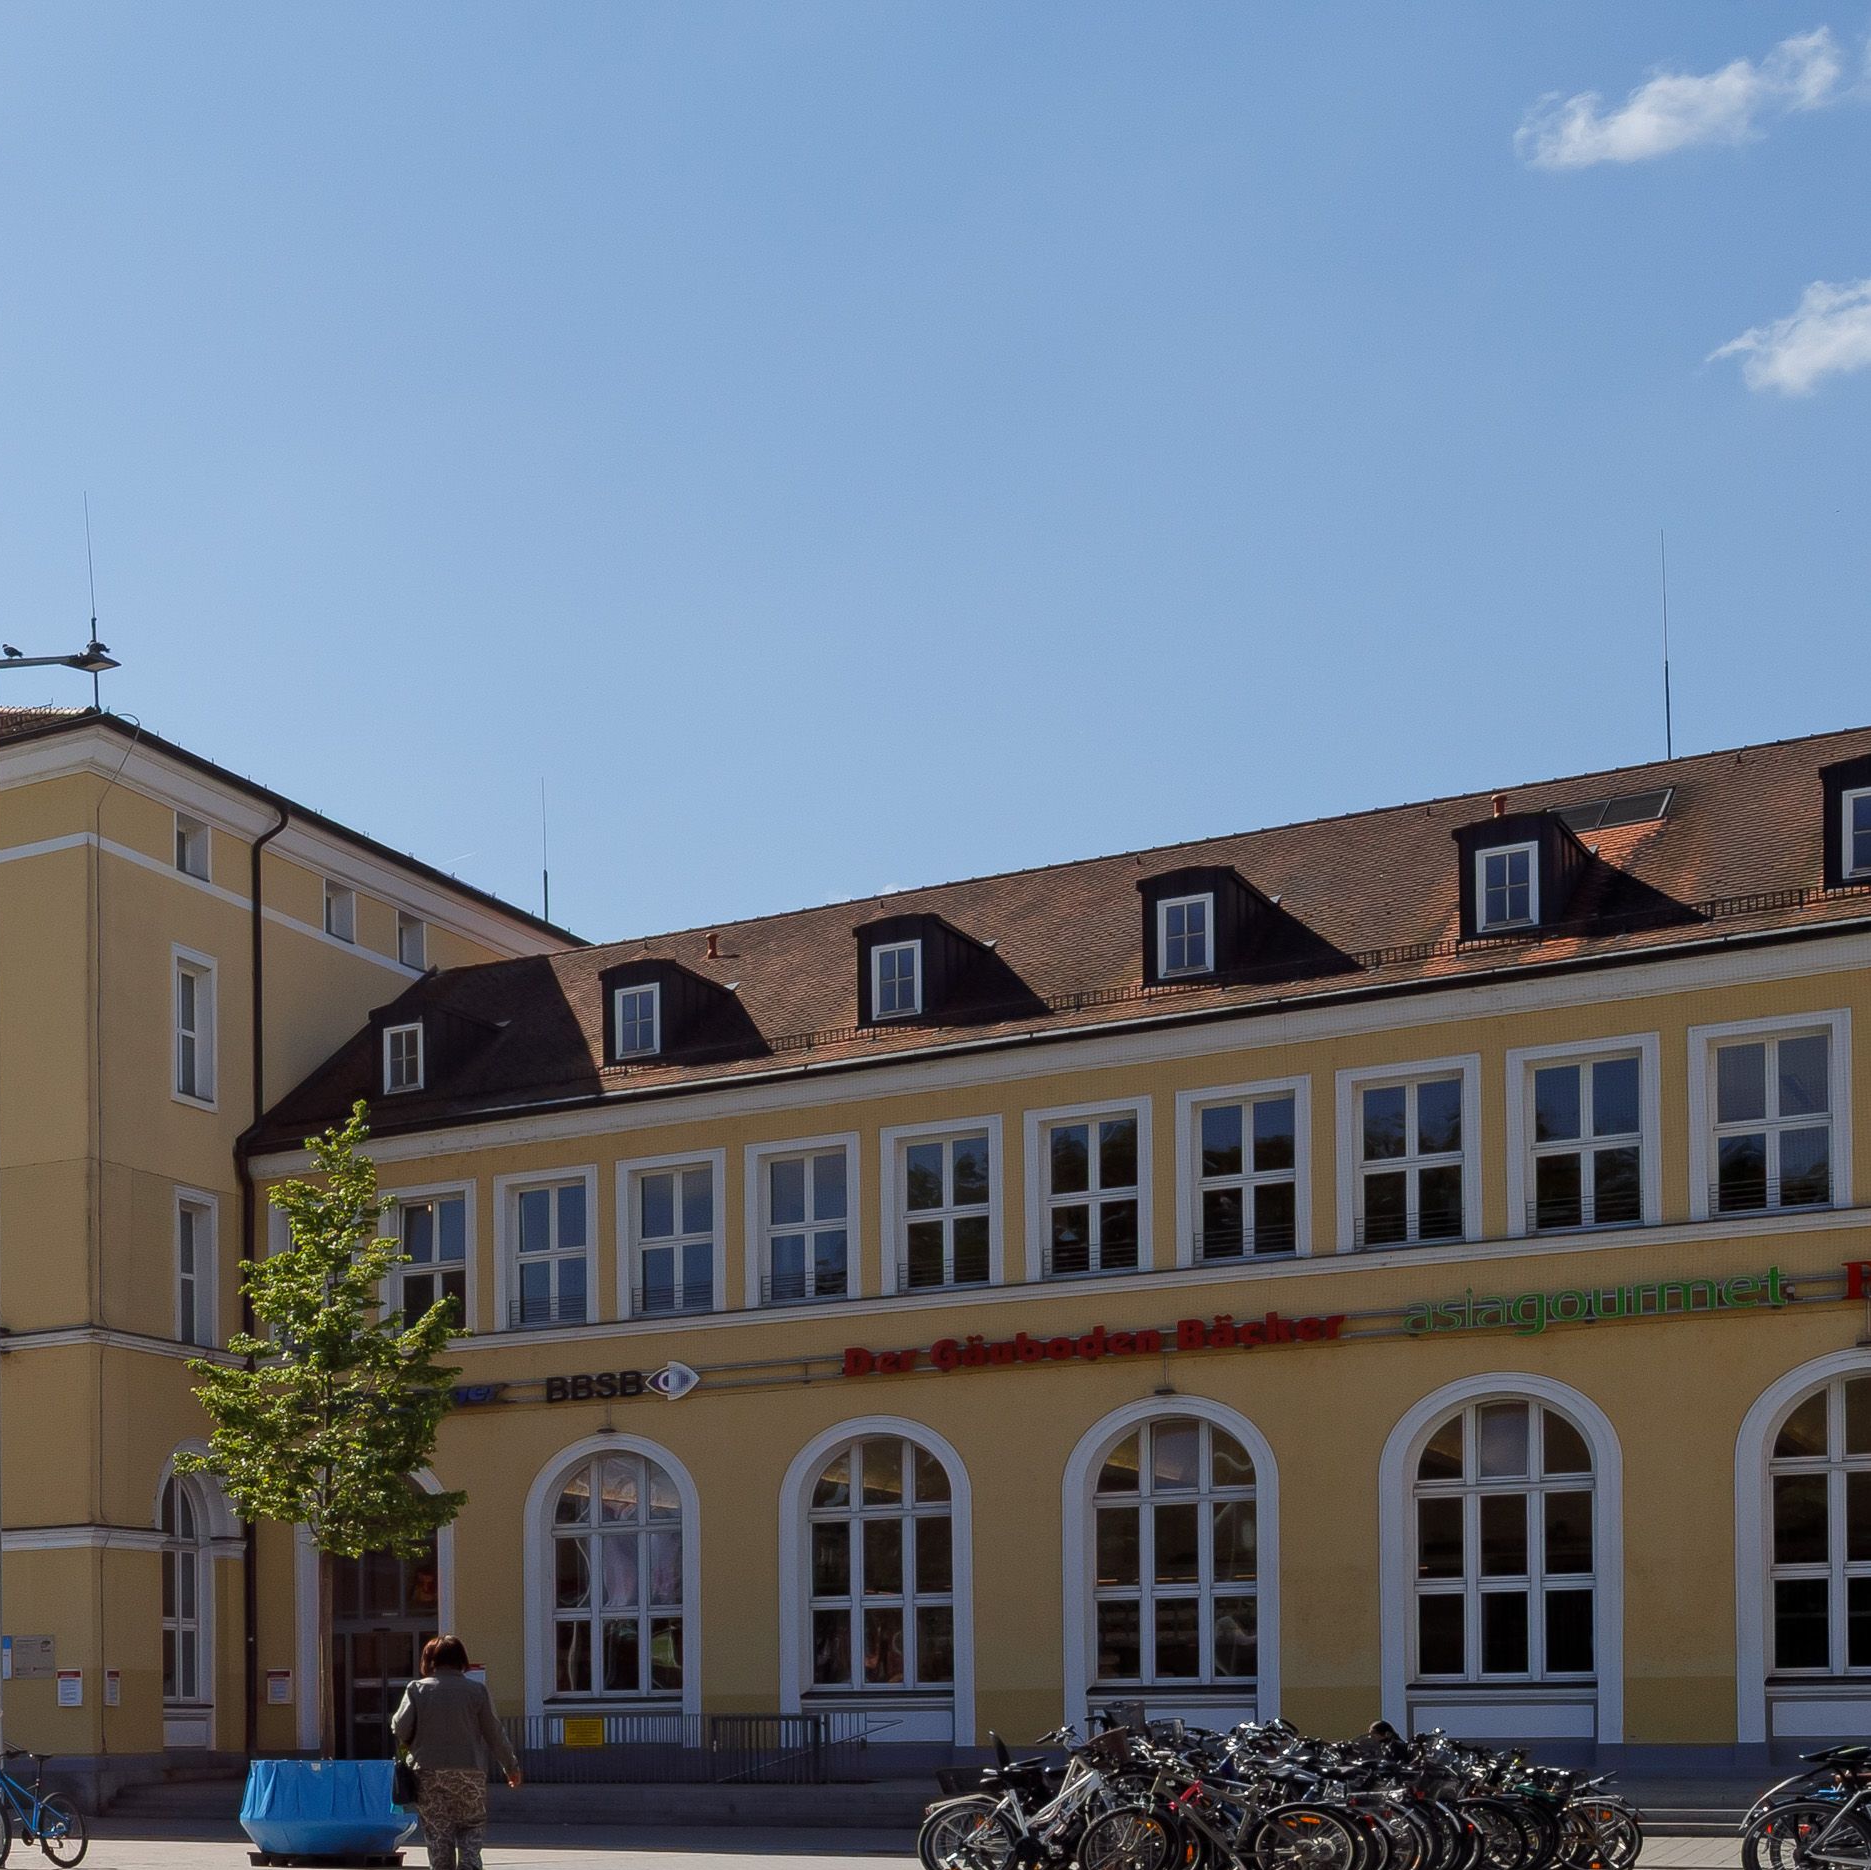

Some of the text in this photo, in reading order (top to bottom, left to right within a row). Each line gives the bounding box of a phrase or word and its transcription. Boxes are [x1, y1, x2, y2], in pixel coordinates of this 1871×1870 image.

[1401, 1265, 1788, 1335] asiagourmet
[843, 1312, 1346, 1377] Der Gäuboden Bäcker
[546, 1370, 644, 1403] BBSB
